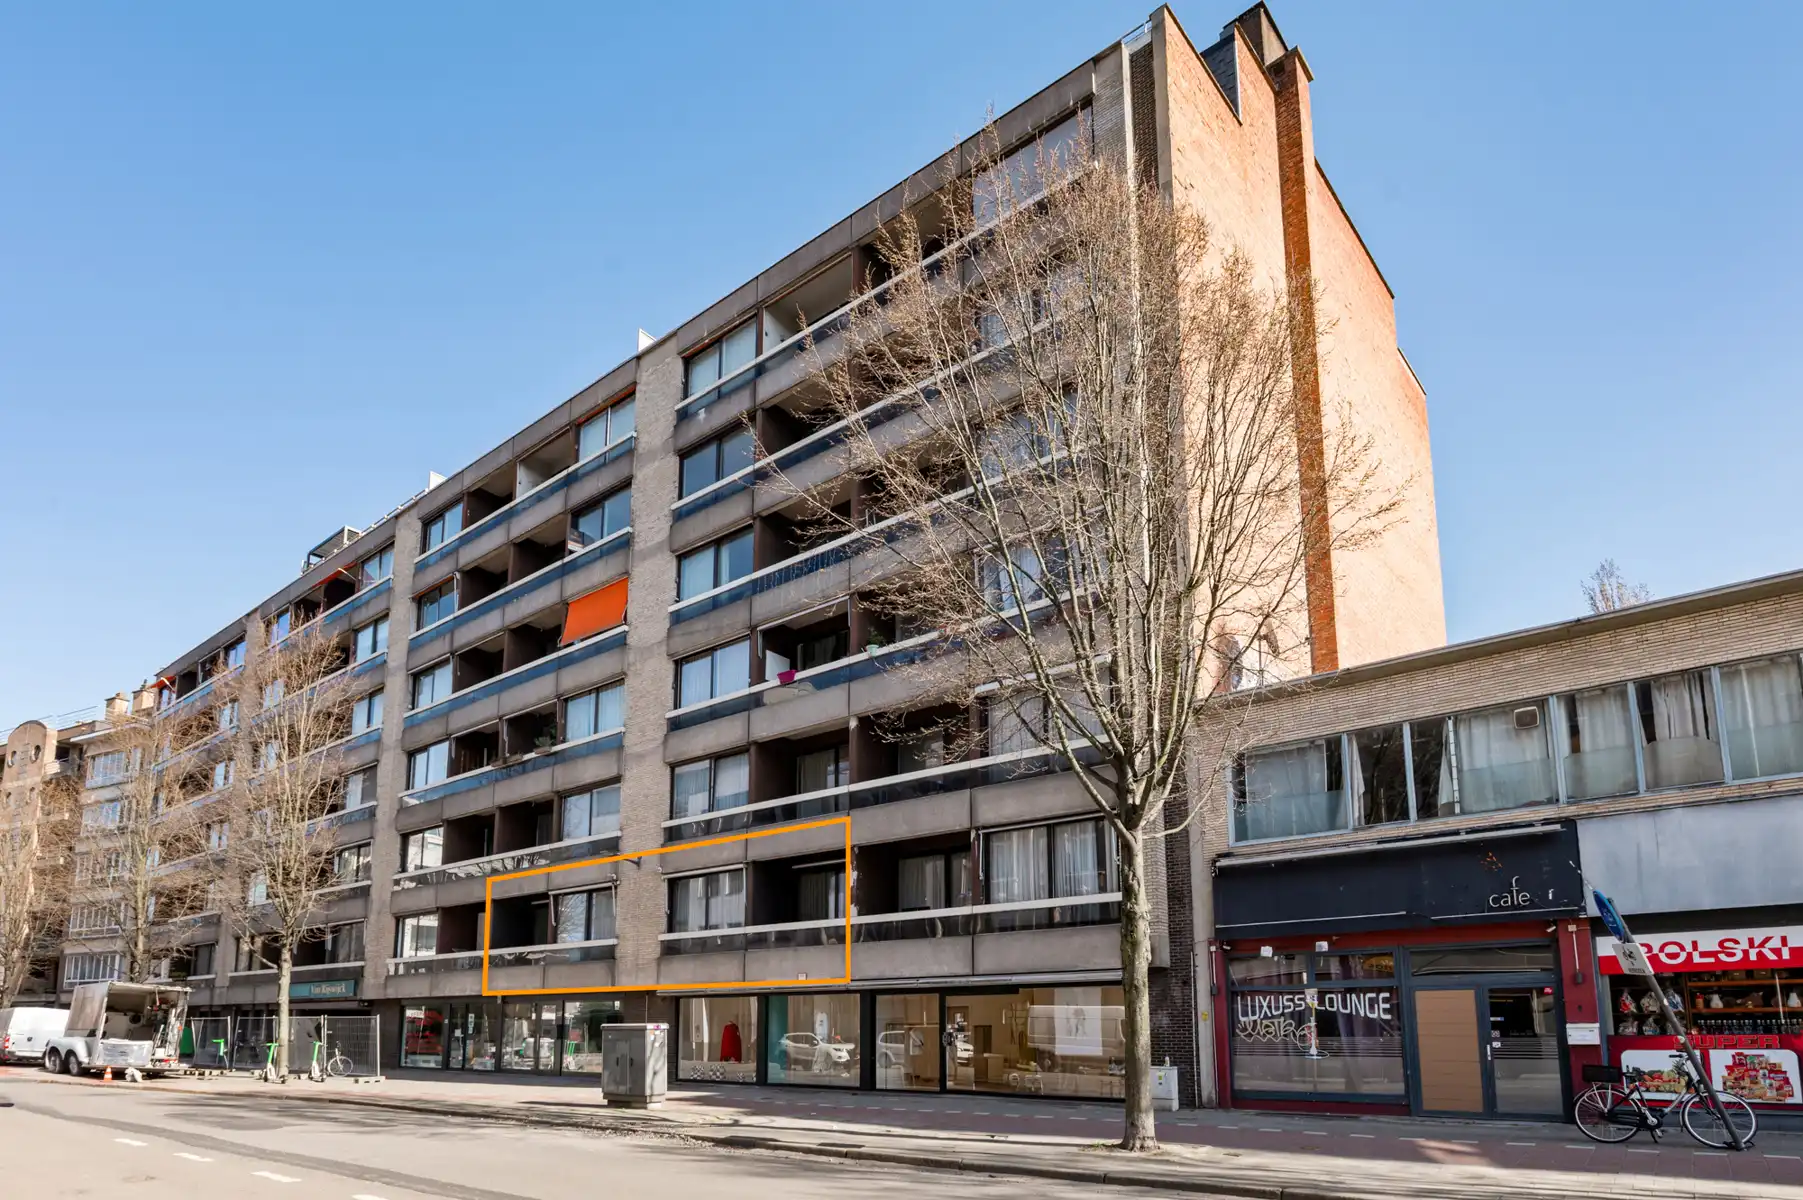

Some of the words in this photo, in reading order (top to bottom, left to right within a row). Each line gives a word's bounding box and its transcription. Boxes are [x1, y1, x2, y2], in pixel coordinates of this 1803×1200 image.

[1489, 875, 1531, 908] cafe
[1237, 994, 1305, 1021] LUXUSS
[1315, 992, 1392, 1020] LOUNGE
[1673, 1034, 1780, 1049] SUPER
